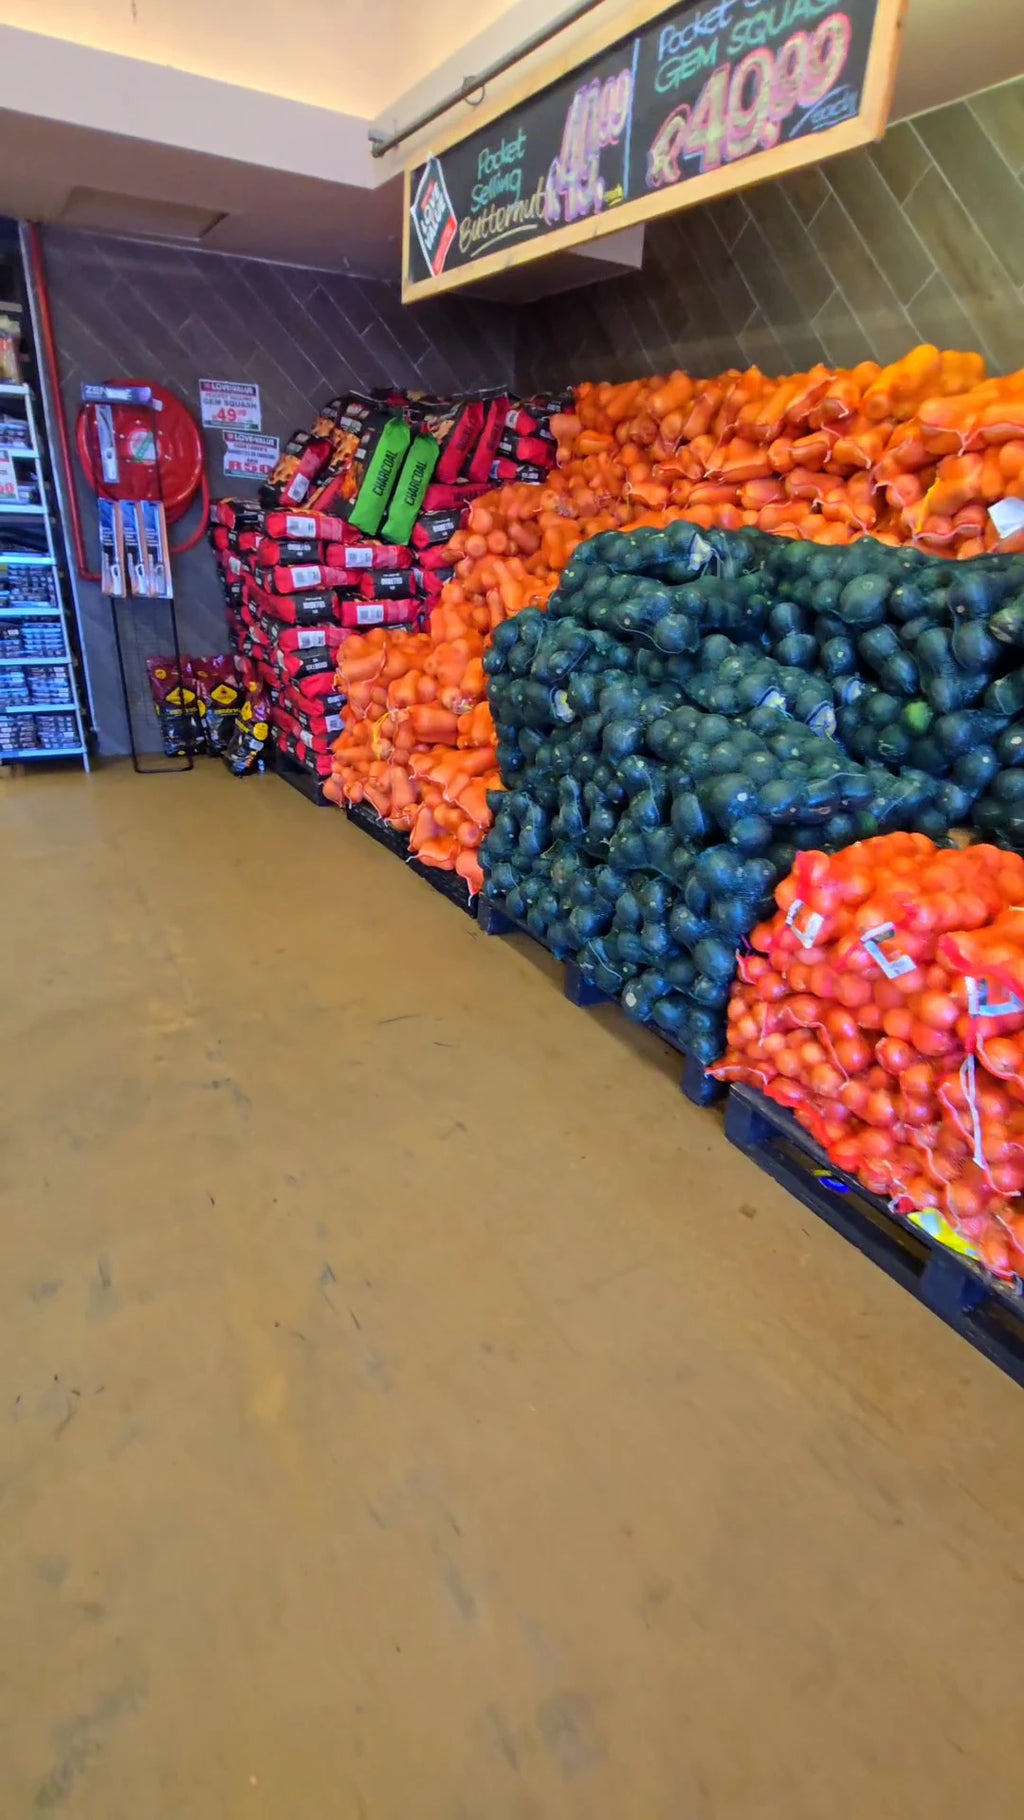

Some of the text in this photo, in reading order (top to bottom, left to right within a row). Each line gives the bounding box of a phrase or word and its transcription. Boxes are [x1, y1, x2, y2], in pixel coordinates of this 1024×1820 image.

[655, 37, 719, 93] GEM
[478, 128, 527, 180] Pocket
[459, 176, 547, 254] Butternut
[470, 168, 522, 213] Selling
[371, 449, 399, 497] CHARCOAL
[404, 461, 428, 507] CHARCOAL
